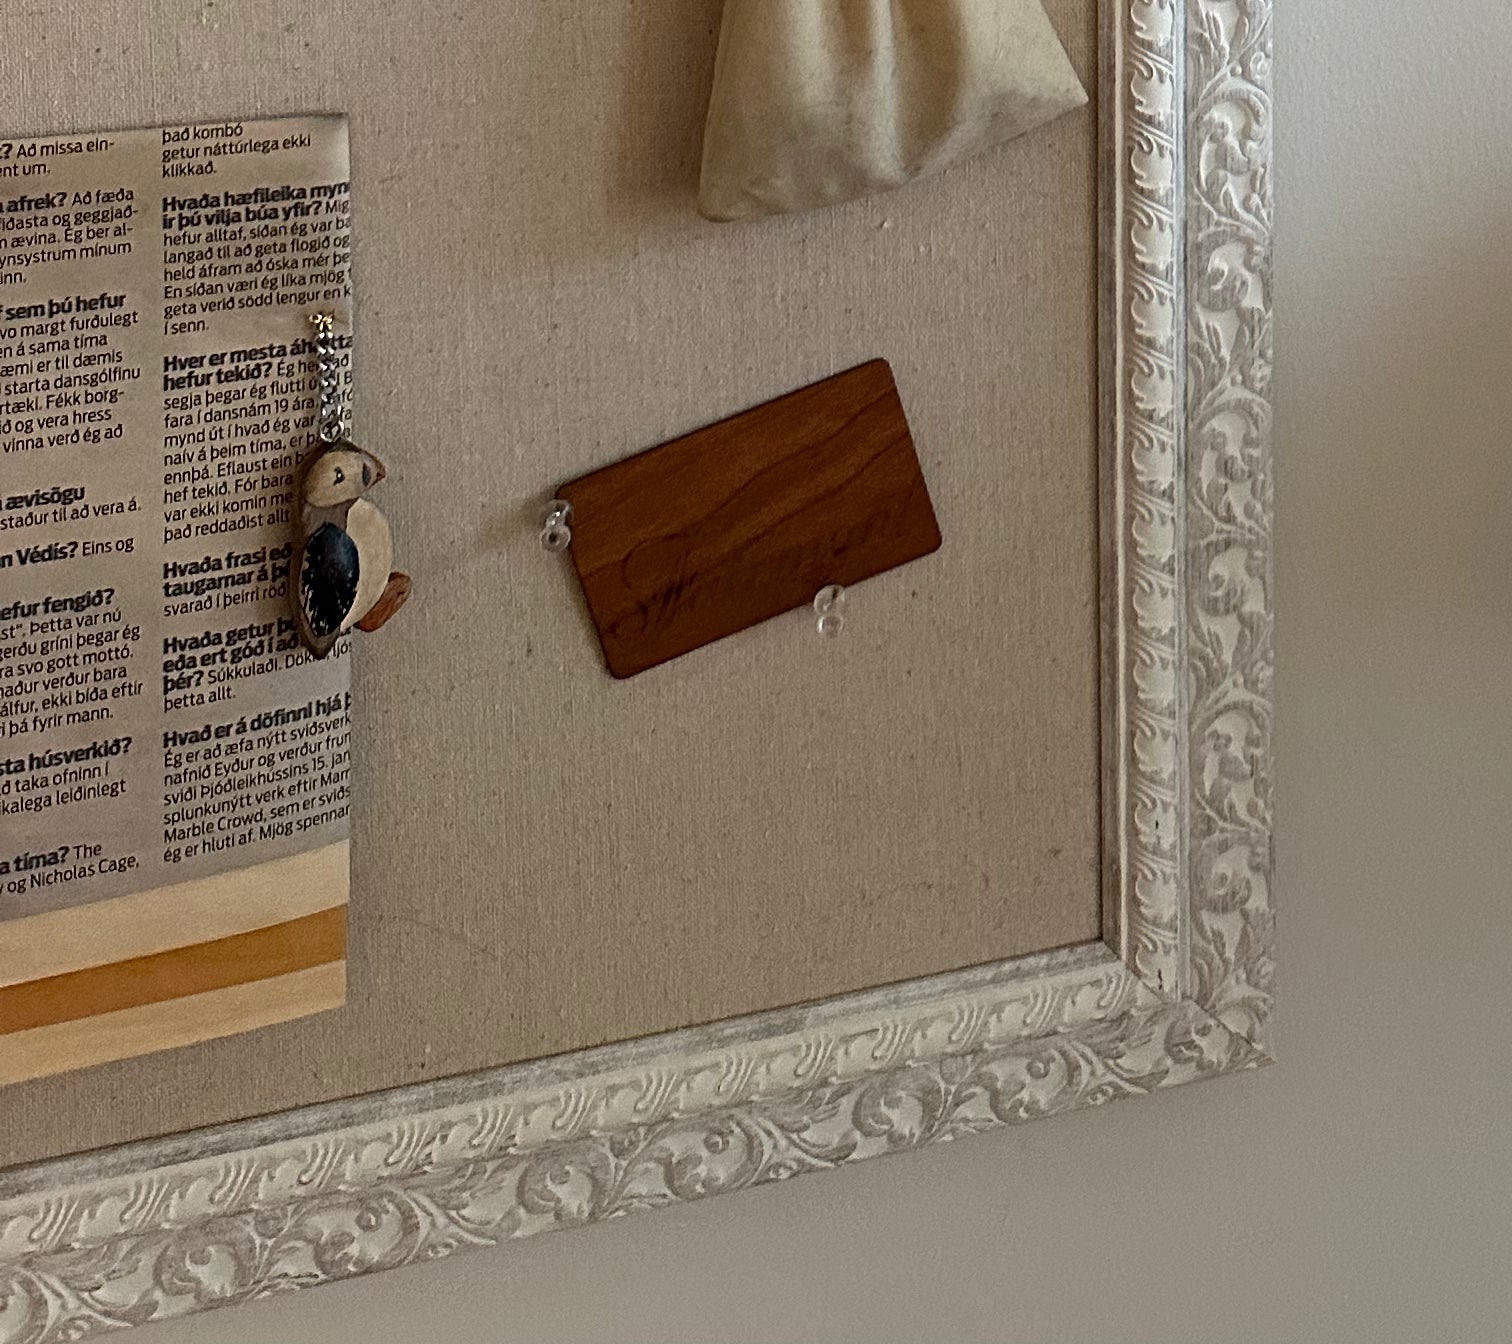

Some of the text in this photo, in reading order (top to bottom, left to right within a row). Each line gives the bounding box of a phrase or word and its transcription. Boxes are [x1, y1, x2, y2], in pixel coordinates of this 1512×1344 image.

[161, 120, 243, 145] það kombó
[39, 140, 83, 157] missa
[161, 145, 200, 163] getur
[282, 133, 310, 149] ekki
[162, 159, 217, 178] klikkað.
[6, 187, 134, 213] afrek? fæða
[162, 193, 220, 212] Hvaða
[73, 204, 138, 226] geggjað-
[203, 199, 322, 227] vilja búa yfir?
[10, 224, 110, 248] ævina. ber
[163, 225, 246, 247] hefur alltaf,
[79, 241, 131, 259] mínum
[163, 245, 213, 265] langað
[163, 262, 242, 282] held áfram
[47, 292, 126, 319] þú hefur
[163, 290, 320, 319] geta verið lengur
[20, 318, 67, 337] margt
[28, 333, 108, 355] sama tíma
[72, 348, 122, 368] dæmis
[163, 354, 206, 372] Hver
[4, 377, 50, 396] starta
[163, 360, 273, 391] hefur tekið?
[45, 389, 81, 409] Fékk
[163, 391, 202, 411] segja
[203, 397, 288, 423] dansnám 19
[36, 408, 112, 430] vera hress
[2, 435, 44, 453] vinna
[164, 427, 205, 448] mynd
[249, 437, 286, 454] tíma,
[163, 457, 267, 485] ennþá. Eflaust
[5, 486, 85, 510] ævisögu
[191, 475, 258, 500] tekið. Fór
[92, 501, 124, 517] vera
[164, 523, 192, 544] það
[16, 540, 112, 565] Védís? Eins
[41, 587, 115, 615] fengið?
[29, 616, 72, 636] Þetta
[76, 629, 120, 650] þegar
[162, 630, 223, 655] Hvaða
[45, 643, 133, 674] gott mottó.
[42, 666, 127, 690] verður bara
[162, 669, 204, 694] þér?
[41, 680, 143, 711] ekki eftir
[164, 684, 235, 713] þetta allt.
[32, 707, 113, 732] fyrir mann.
[162, 723, 212, 748] Hvað
[256, 729, 287, 749] nýtt
[14, 765, 101, 793] taka ofninn
[164, 757, 255, 786] nafnið Eyður
[163, 784, 197, 806] sviði
[254, 784, 286, 804] verk
[163, 807, 267, 843] Marble Crowd,
[259, 820, 293, 840] Mjög
[13, 843, 102, 872] tíma? The
[6, 855, 139, 893] og Nicholas Cage,
